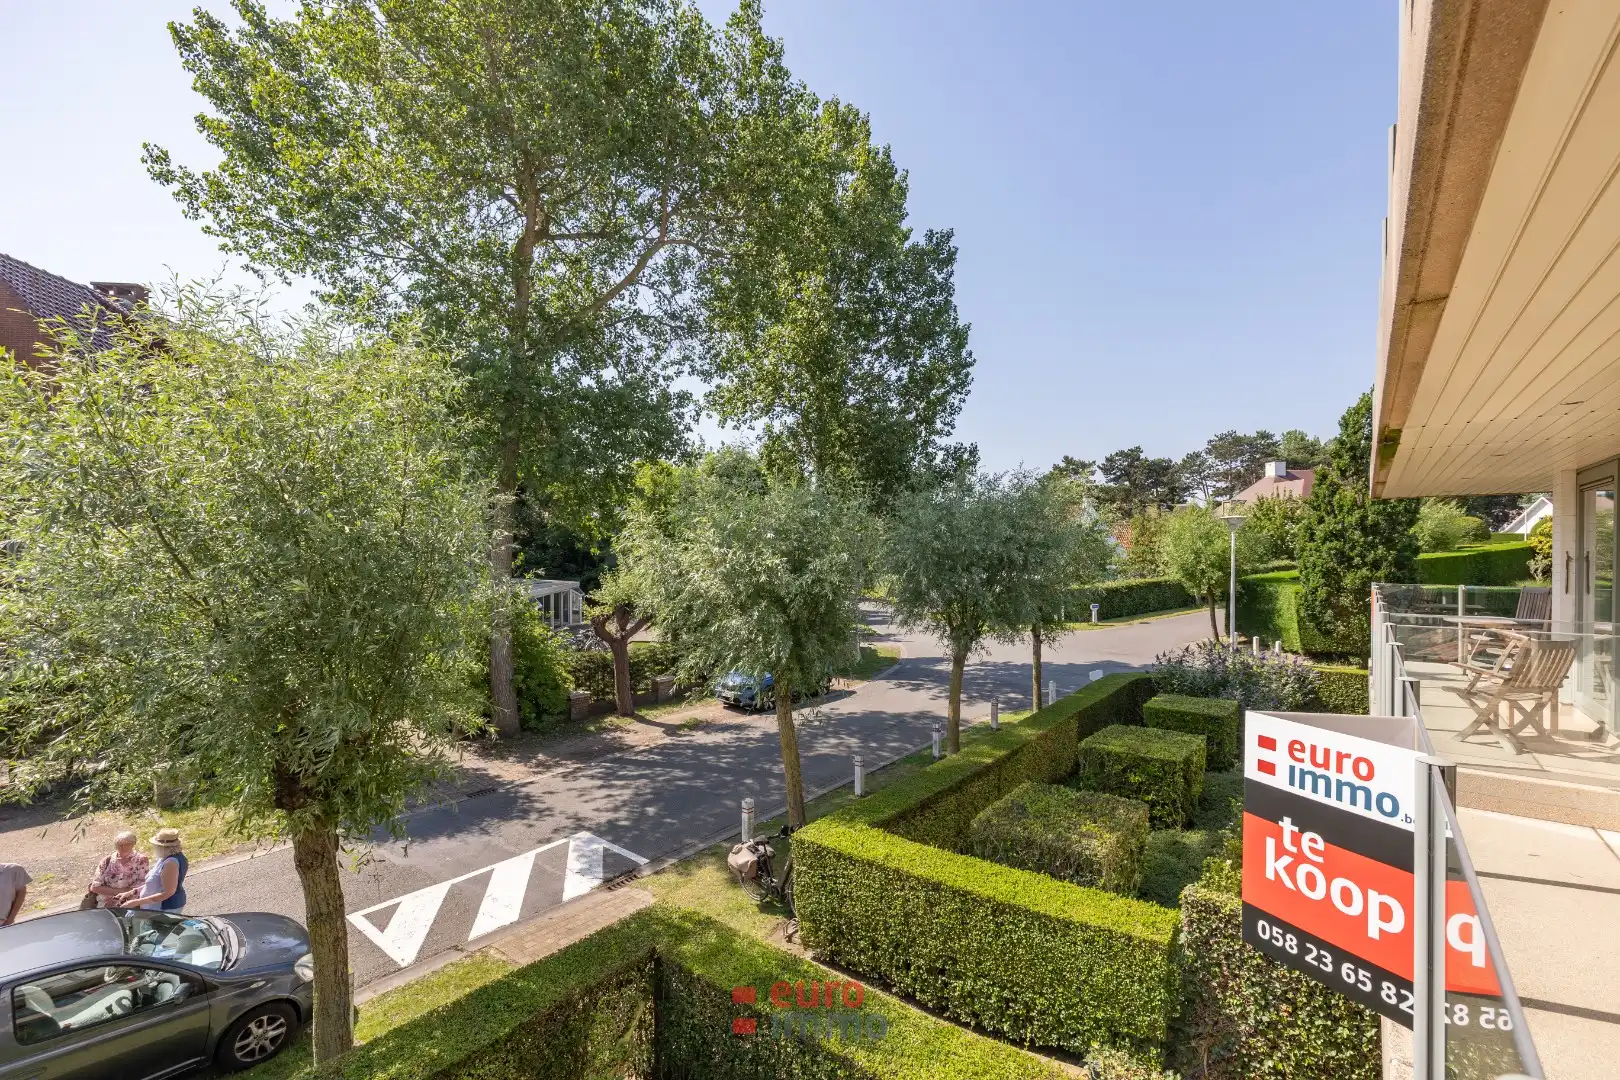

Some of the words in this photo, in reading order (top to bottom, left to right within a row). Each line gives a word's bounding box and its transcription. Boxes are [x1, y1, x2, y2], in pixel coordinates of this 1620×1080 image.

[1288, 740, 1375, 781] euro
[1279, 816, 1325, 863] te
[1265, 836, 1405, 940] koop
[1257, 919, 1299, 954] 058
[1304, 944, 1333, 973] 23
[1341, 963, 1372, 992] 65
[1381, 981, 1414, 1015] 82
